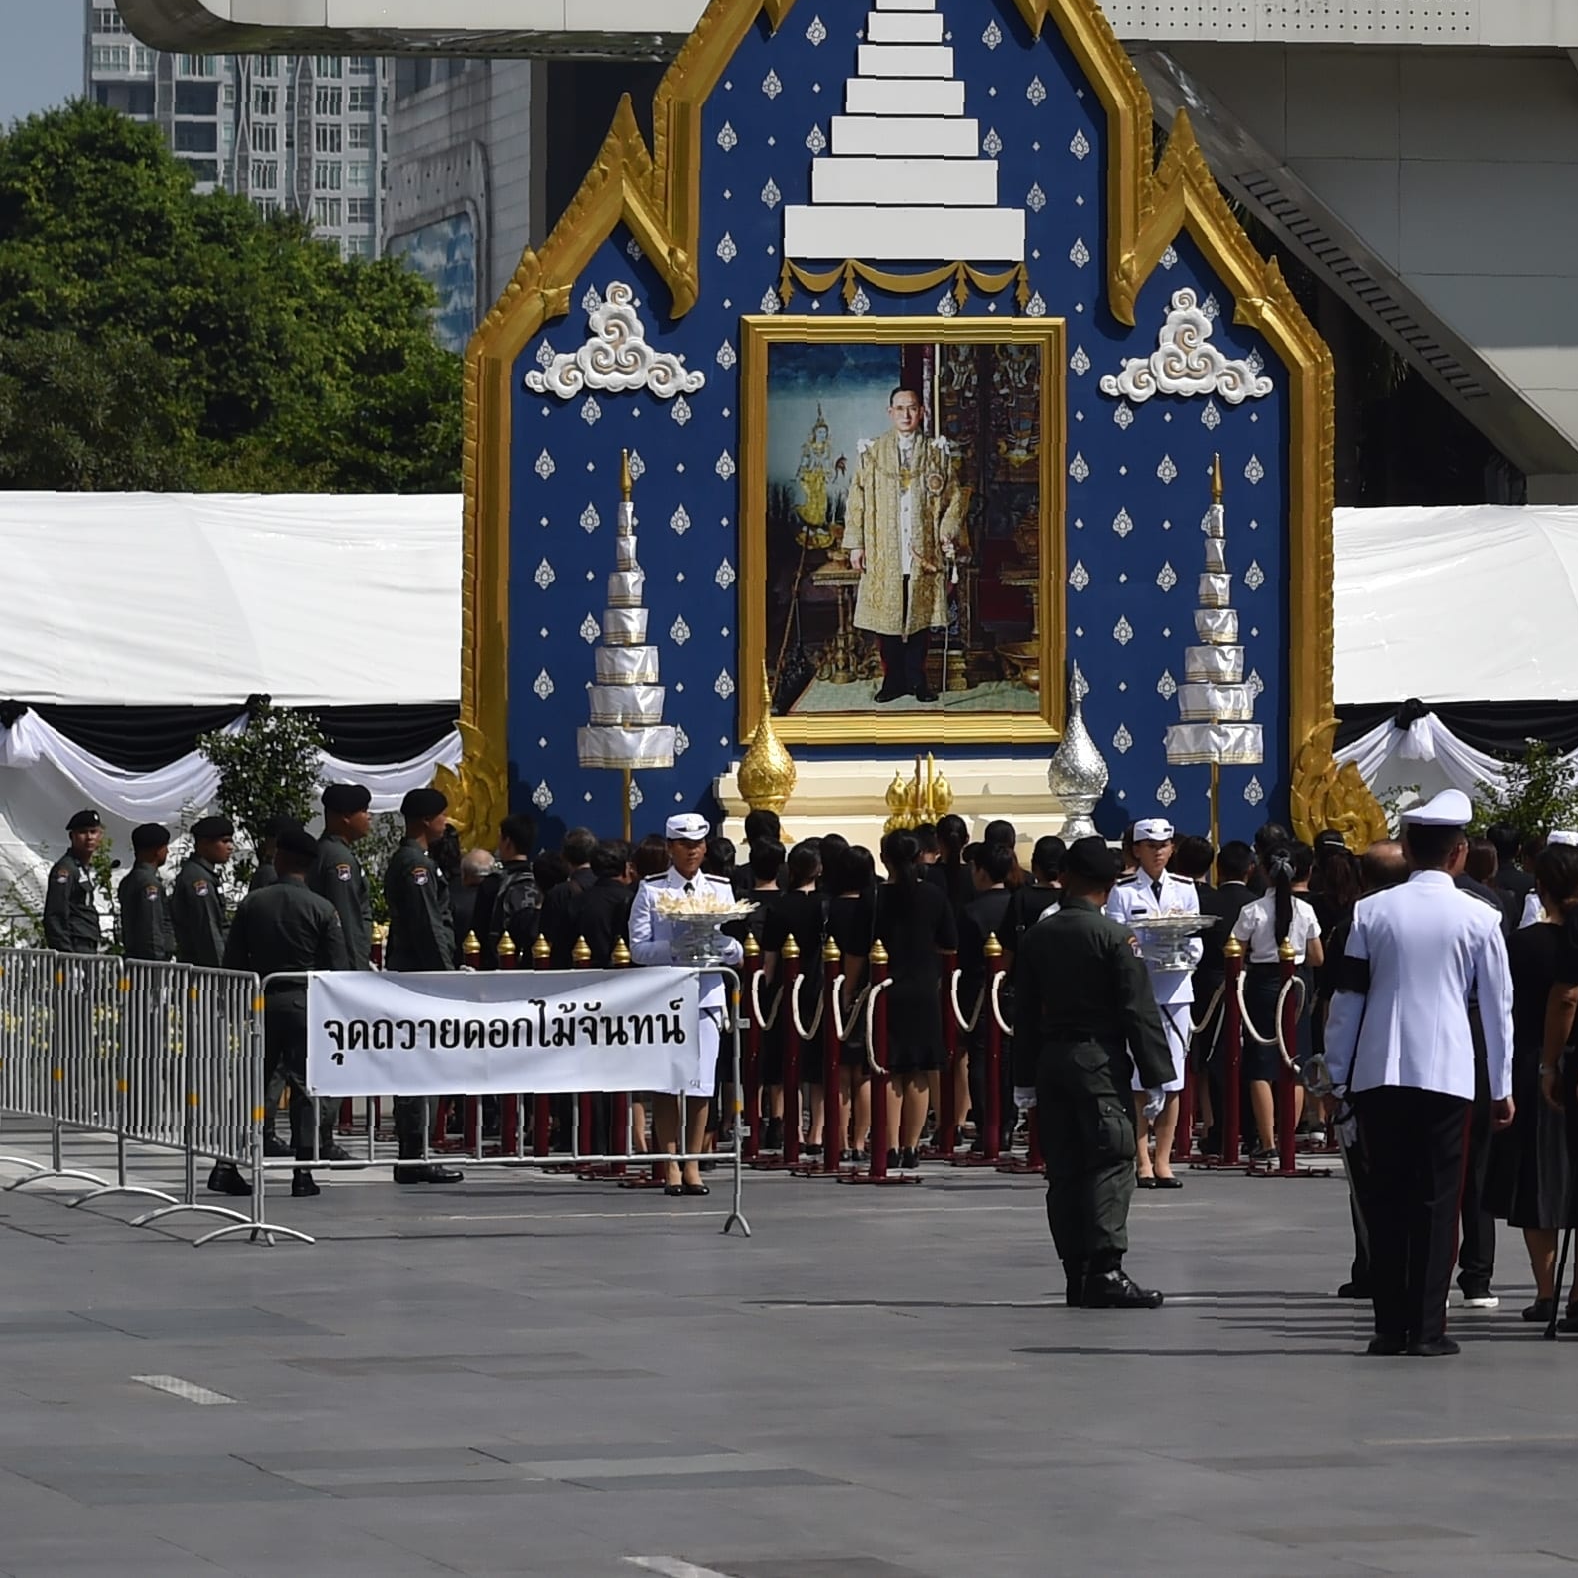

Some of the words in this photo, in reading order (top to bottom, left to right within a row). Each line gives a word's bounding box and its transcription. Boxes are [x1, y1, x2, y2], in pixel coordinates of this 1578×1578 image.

[323, 997, 685, 1066] จุดถวายดอกไม้จันทน์
